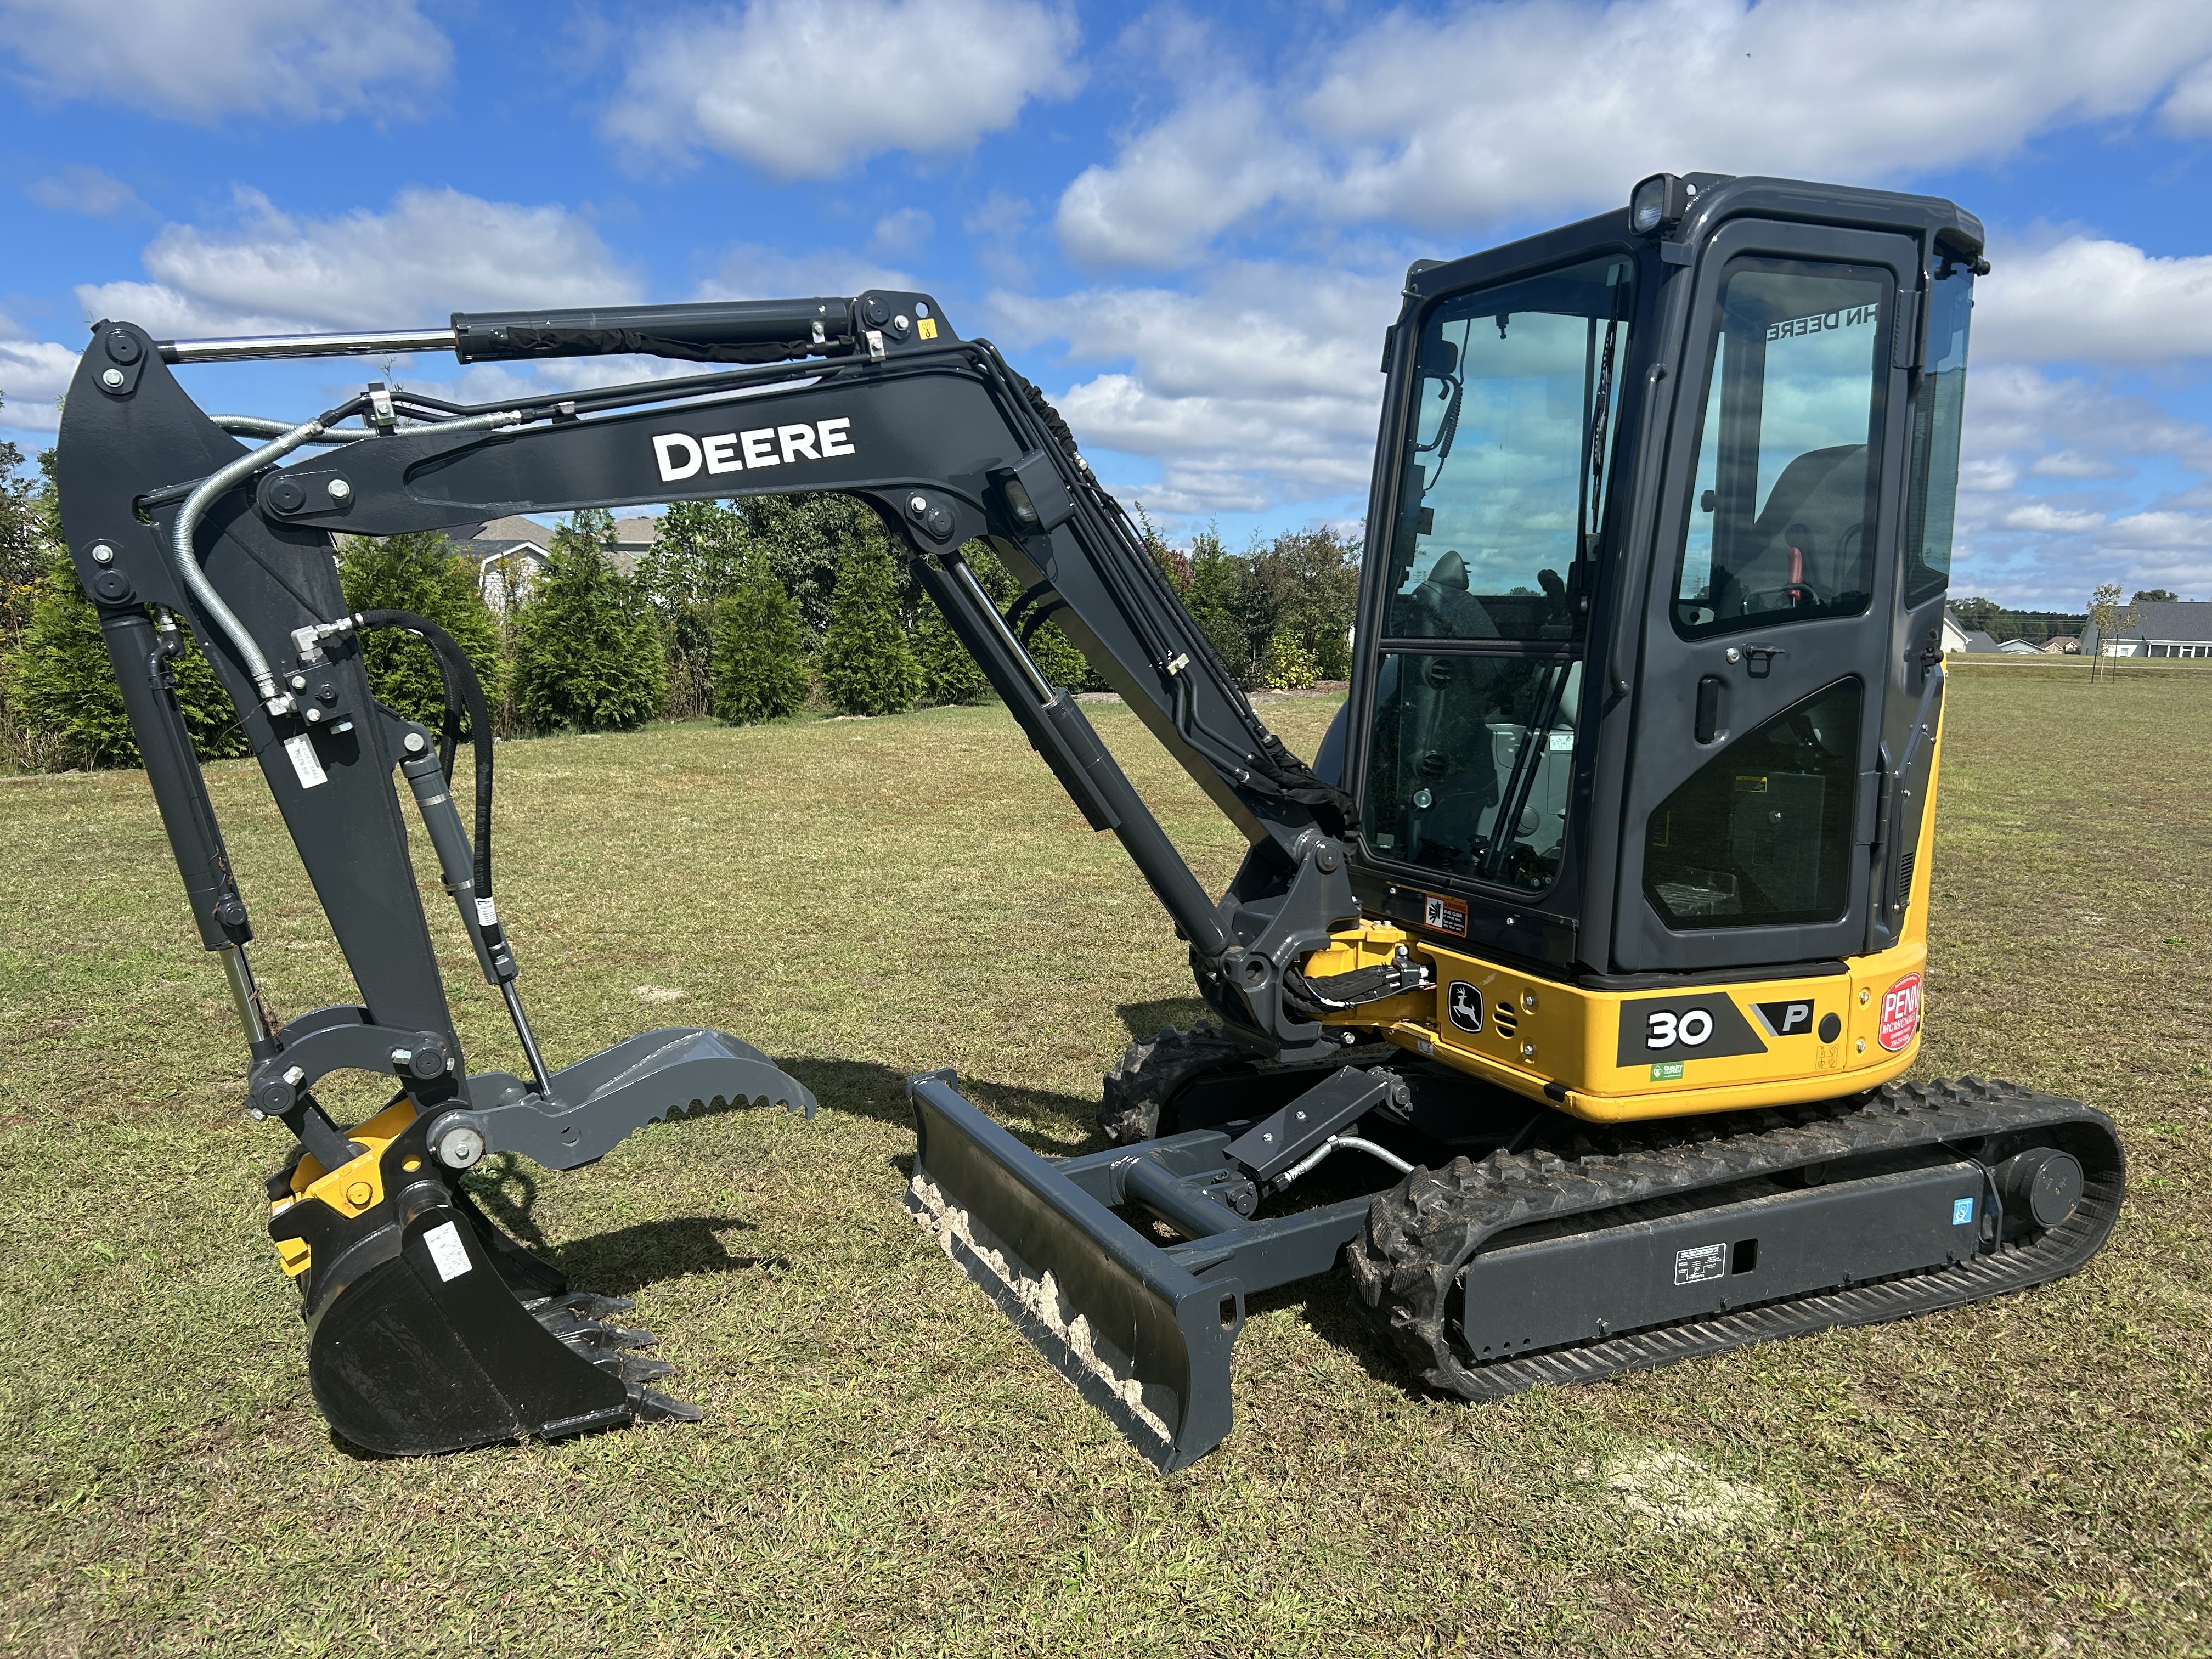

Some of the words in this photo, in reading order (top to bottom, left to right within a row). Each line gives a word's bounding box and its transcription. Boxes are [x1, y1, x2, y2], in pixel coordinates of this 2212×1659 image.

[652, 417, 855, 482] DEERE
[310, 765, 319, 778] TYPE
[1783, 1005, 1808, 1032] P
[1884, 982, 1920, 1022] PENN
[1646, 1008, 1713, 1049] 30
